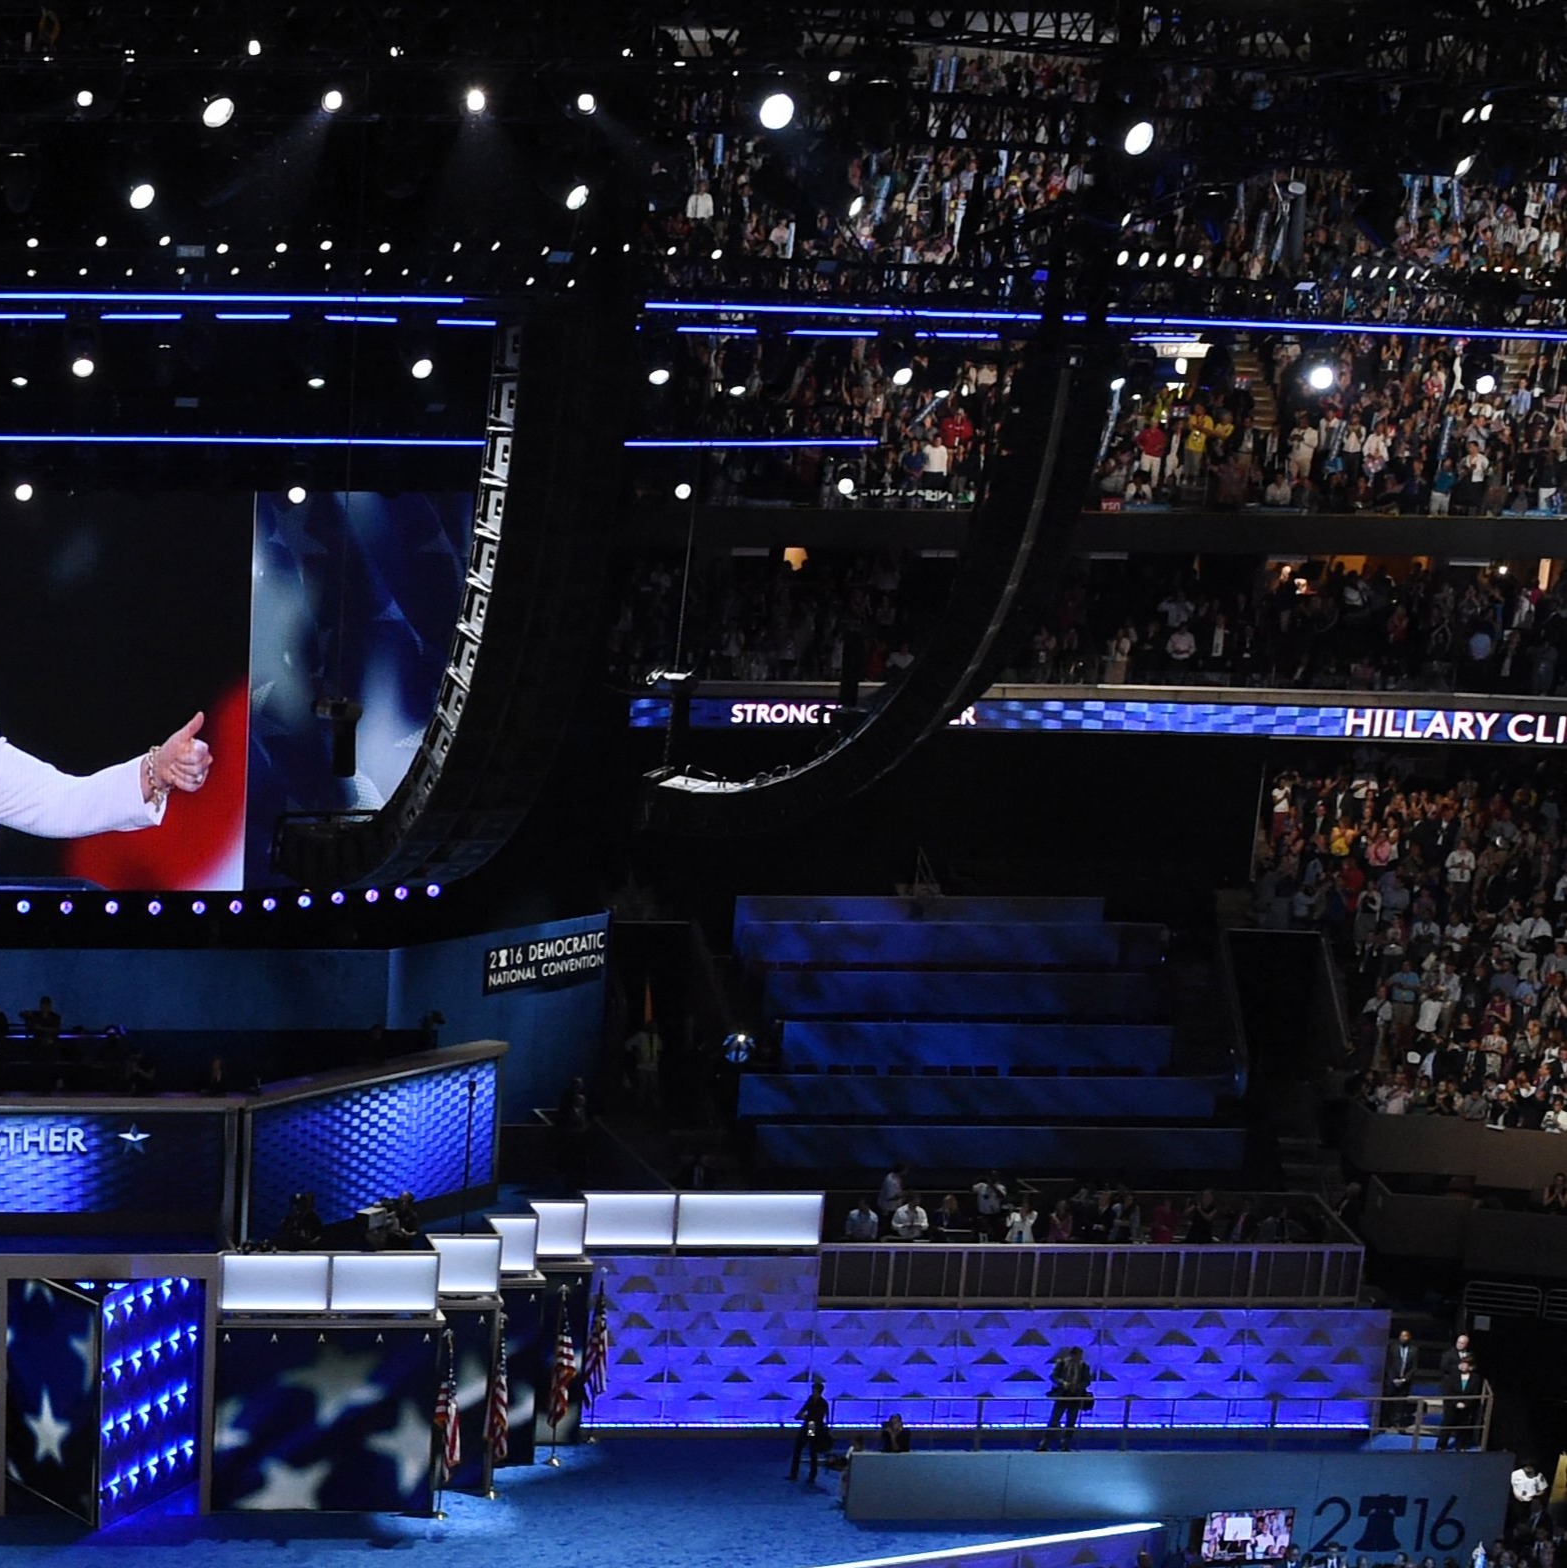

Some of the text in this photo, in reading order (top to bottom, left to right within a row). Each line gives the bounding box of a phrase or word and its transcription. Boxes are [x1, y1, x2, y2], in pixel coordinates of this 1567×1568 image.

[1344, 708, 1500, 741] HILLARY
[528, 932, 605, 961] DEMOCRATIC
[488, 953, 604, 987] NATIONAL CONVENTION
